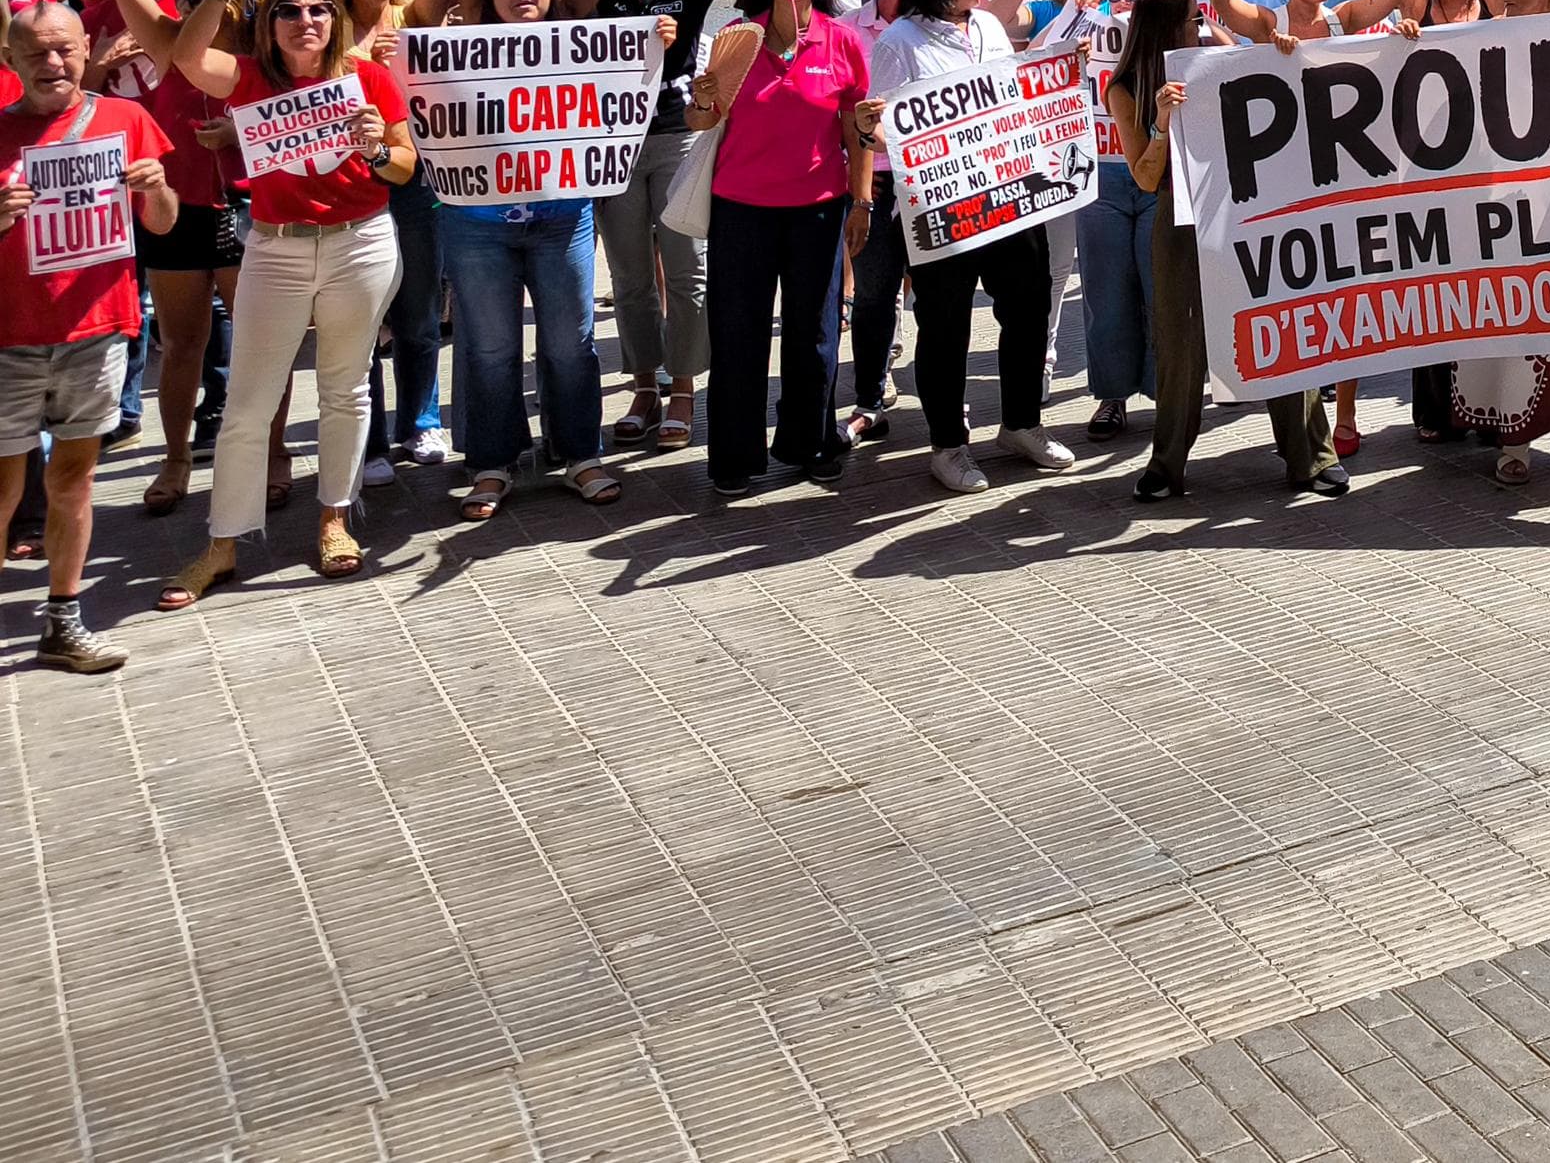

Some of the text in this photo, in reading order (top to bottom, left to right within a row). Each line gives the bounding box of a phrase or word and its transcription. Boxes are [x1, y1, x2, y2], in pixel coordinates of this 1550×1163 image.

[407, 33, 542, 75] Navarro
[551, 27, 561, 65] i
[570, 24, 649, 64] Soler
[243, 97, 360, 142] SOLUCIONS
[256, 83, 345, 120] VOLEM
[409, 82, 649, 140] Sou inCAPAços
[893, 74, 1020, 135] CRESPIN i el
[265, 120, 353, 154] VOLEM
[909, 93, 1088, 166] PROU VOLEM SOLUCIONS.
[919, 115, 1090, 186] DEIXEU EL I FEU LA FEINA!
[31, 147, 123, 190] AUTOESCOLES
[423, 155, 489, 197] Doncs
[495, 148, 551, 195] CAP
[558, 147, 578, 189] A
[924, 153, 1035, 206] PRO? NO. PROU!
[65, 188, 95, 208] EN
[926, 182, 1030, 230] EL PASSA.
[930, 228, 950, 247] EL
[1033, 185, 1074, 210] QUEDA.
[33, 201, 127, 257] LLUITA
[1232, 206, 1450, 300] VOLEM
